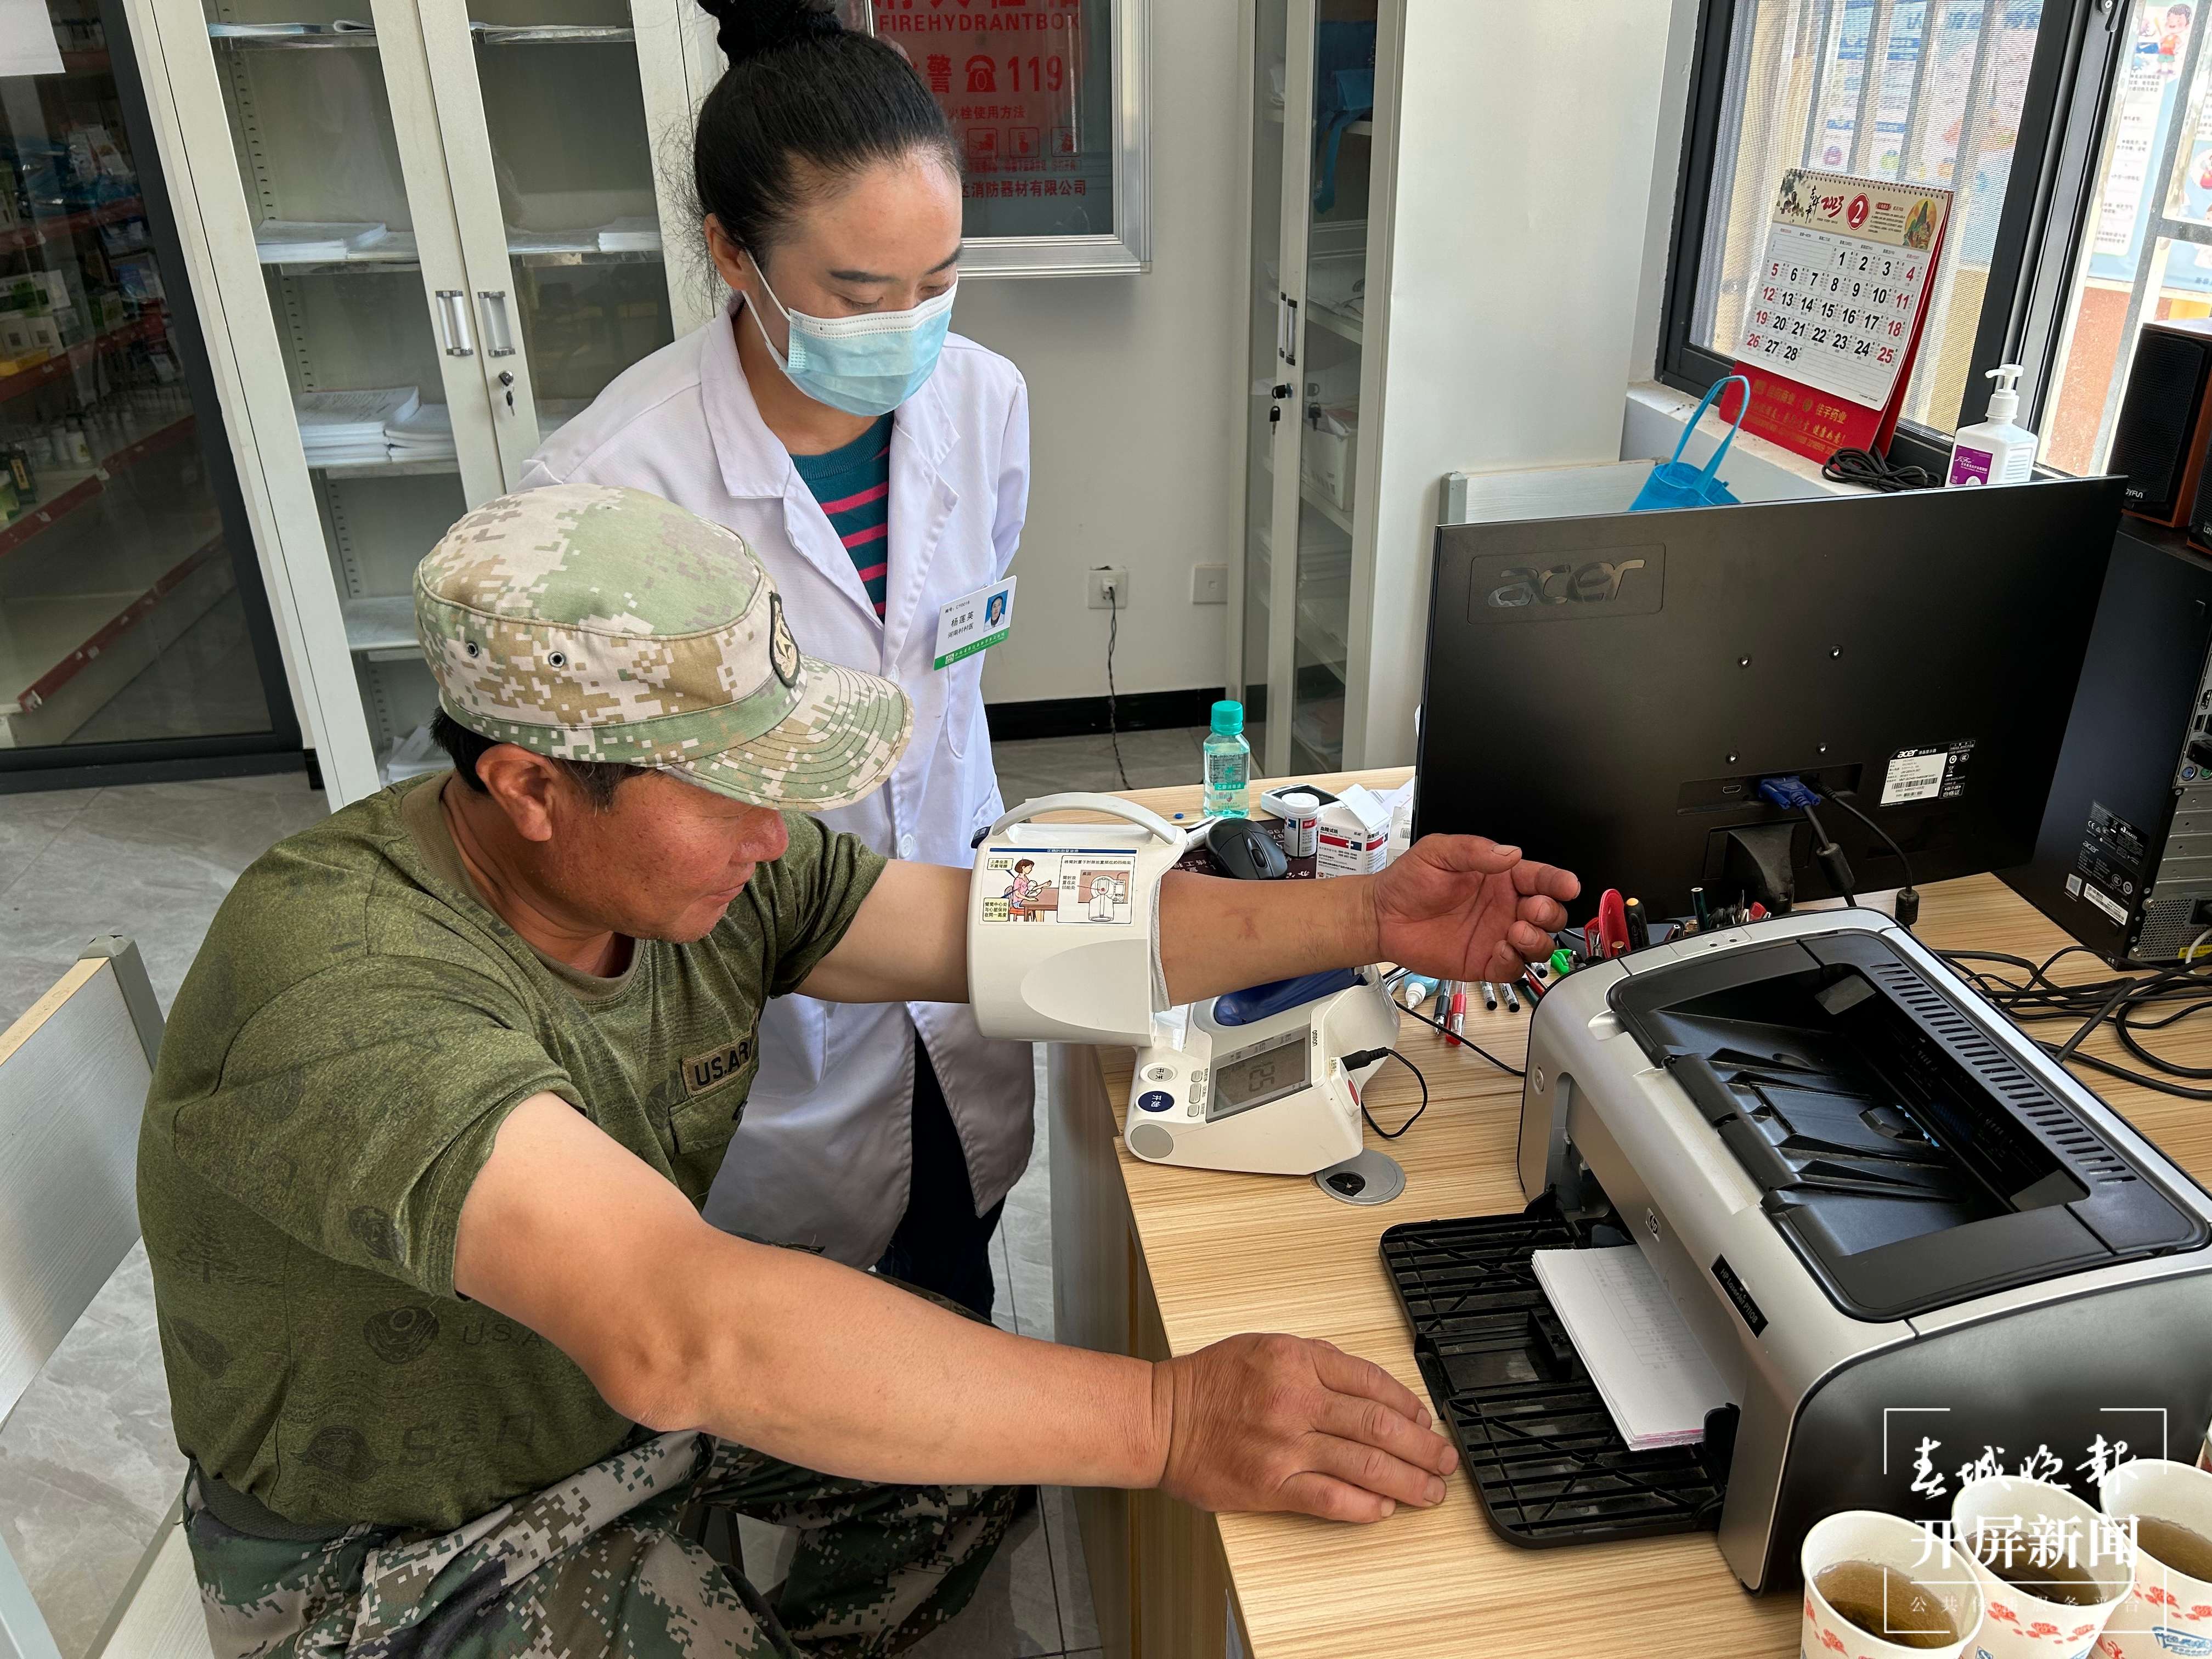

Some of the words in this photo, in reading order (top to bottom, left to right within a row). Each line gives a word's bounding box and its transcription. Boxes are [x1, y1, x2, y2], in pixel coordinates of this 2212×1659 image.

[913, 53, 952, 93] 警
[1008, 55, 1063, 92] 119
[1821, 195, 1844, 218] 2023
[1852, 200, 1864, 224] 2
[1839, 252, 1846, 266] 1
[1859, 256, 1868, 270] 2
[1882, 261, 1891, 275] 3
[1906, 267, 1915, 281] 4
[1771, 263, 1779, 276] 5
[1791, 268, 1798, 281] 6
[1810, 273, 1818, 286] 7
[1831, 278, 1839, 291] 8
[1852, 283, 1860, 297] 9
[1873, 287, 1887, 303] 10
[1897, 294, 1909, 309] 11
[1763, 287, 1775, 301] 12
[1782, 292, 1793, 307] 13
[1801, 297, 1814, 312] 14
[1821, 302, 1835, 318] 15
[1843, 308, 1857, 324] 16
[1865, 314, 1879, 330] 17
[1888, 321, 1901, 337] 18
[1747, 334, 1760, 348] 26
[1765, 339, 1779, 354] 27
[1784, 346, 1798, 360] 28
[1756, 311, 1768, 324] 19
[1773, 316, 1786, 330] 20
[1792, 321, 1805, 336] 21
[1812, 328, 1827, 343] 22
[1832, 334, 1848, 349] 23
[1855, 340, 1871, 356] 24
[1877, 347, 1893, 364] 25
[1487, 558, 1646, 608] acer
[1897, 749, 1918, 758] acer
[2083, 840, 2099, 854] acer
[694, 1038, 752, 1086] US.AR
[1154, 1067, 1165, 1080] 开/关
[1150, 1094, 1163, 1108] 开始
[1649, 1215, 1658, 1234] hp
[1720, 1268, 1729, 1279] HP
[1726, 1277, 1746, 1306] LaserJet
[1743, 1302, 1758, 1324] P1108
